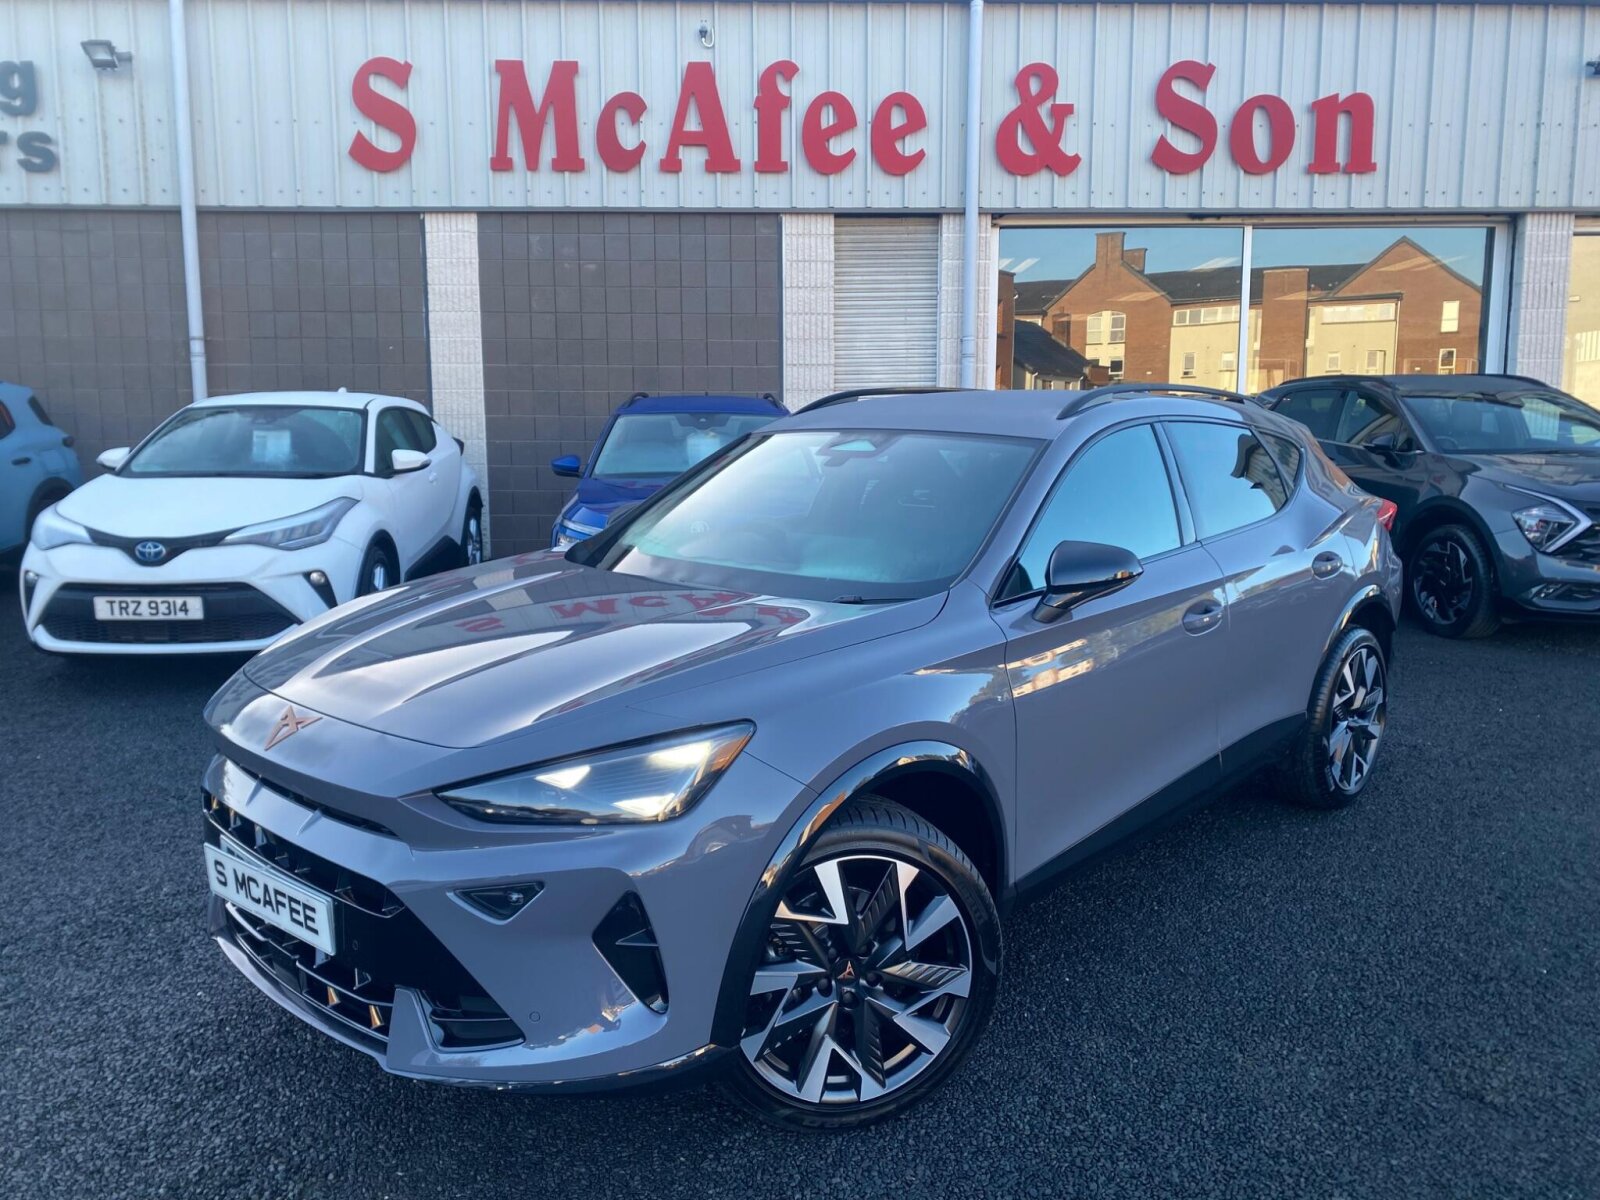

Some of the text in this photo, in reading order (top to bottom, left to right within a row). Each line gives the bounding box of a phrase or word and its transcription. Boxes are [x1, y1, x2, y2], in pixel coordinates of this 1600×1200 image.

[348, 56, 1377, 176] S McAfee & Son
[106, 600, 189, 616] TRZ 9314
[214, 860, 319, 936] S MCAFEE
